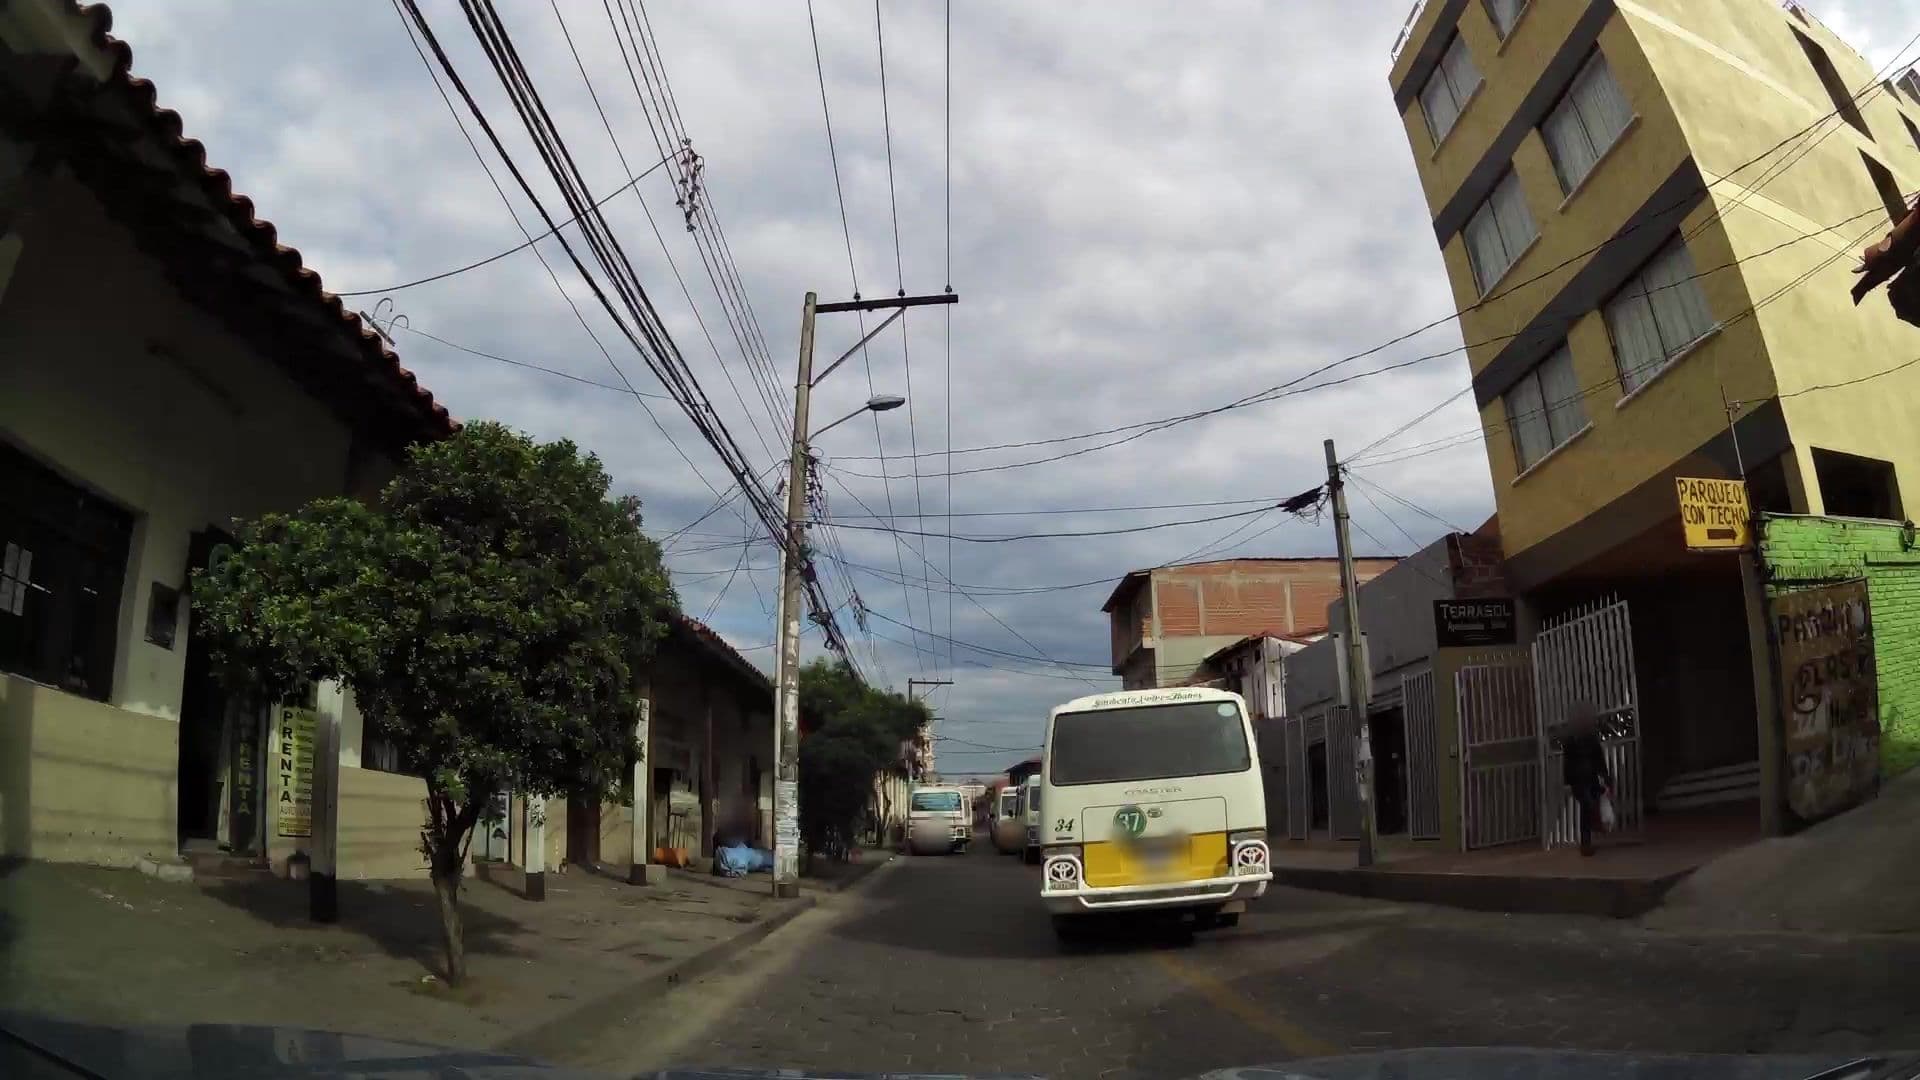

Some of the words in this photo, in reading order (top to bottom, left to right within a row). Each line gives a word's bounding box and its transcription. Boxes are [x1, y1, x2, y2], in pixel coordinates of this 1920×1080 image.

[1678, 480, 1742, 504] PARQUEO
[1683, 504, 1705, 525] CON
[1707, 506, 1746, 526] TECHO
[1054, 818, 1075, 832] 34
[1118, 812, 1139, 832] 37
